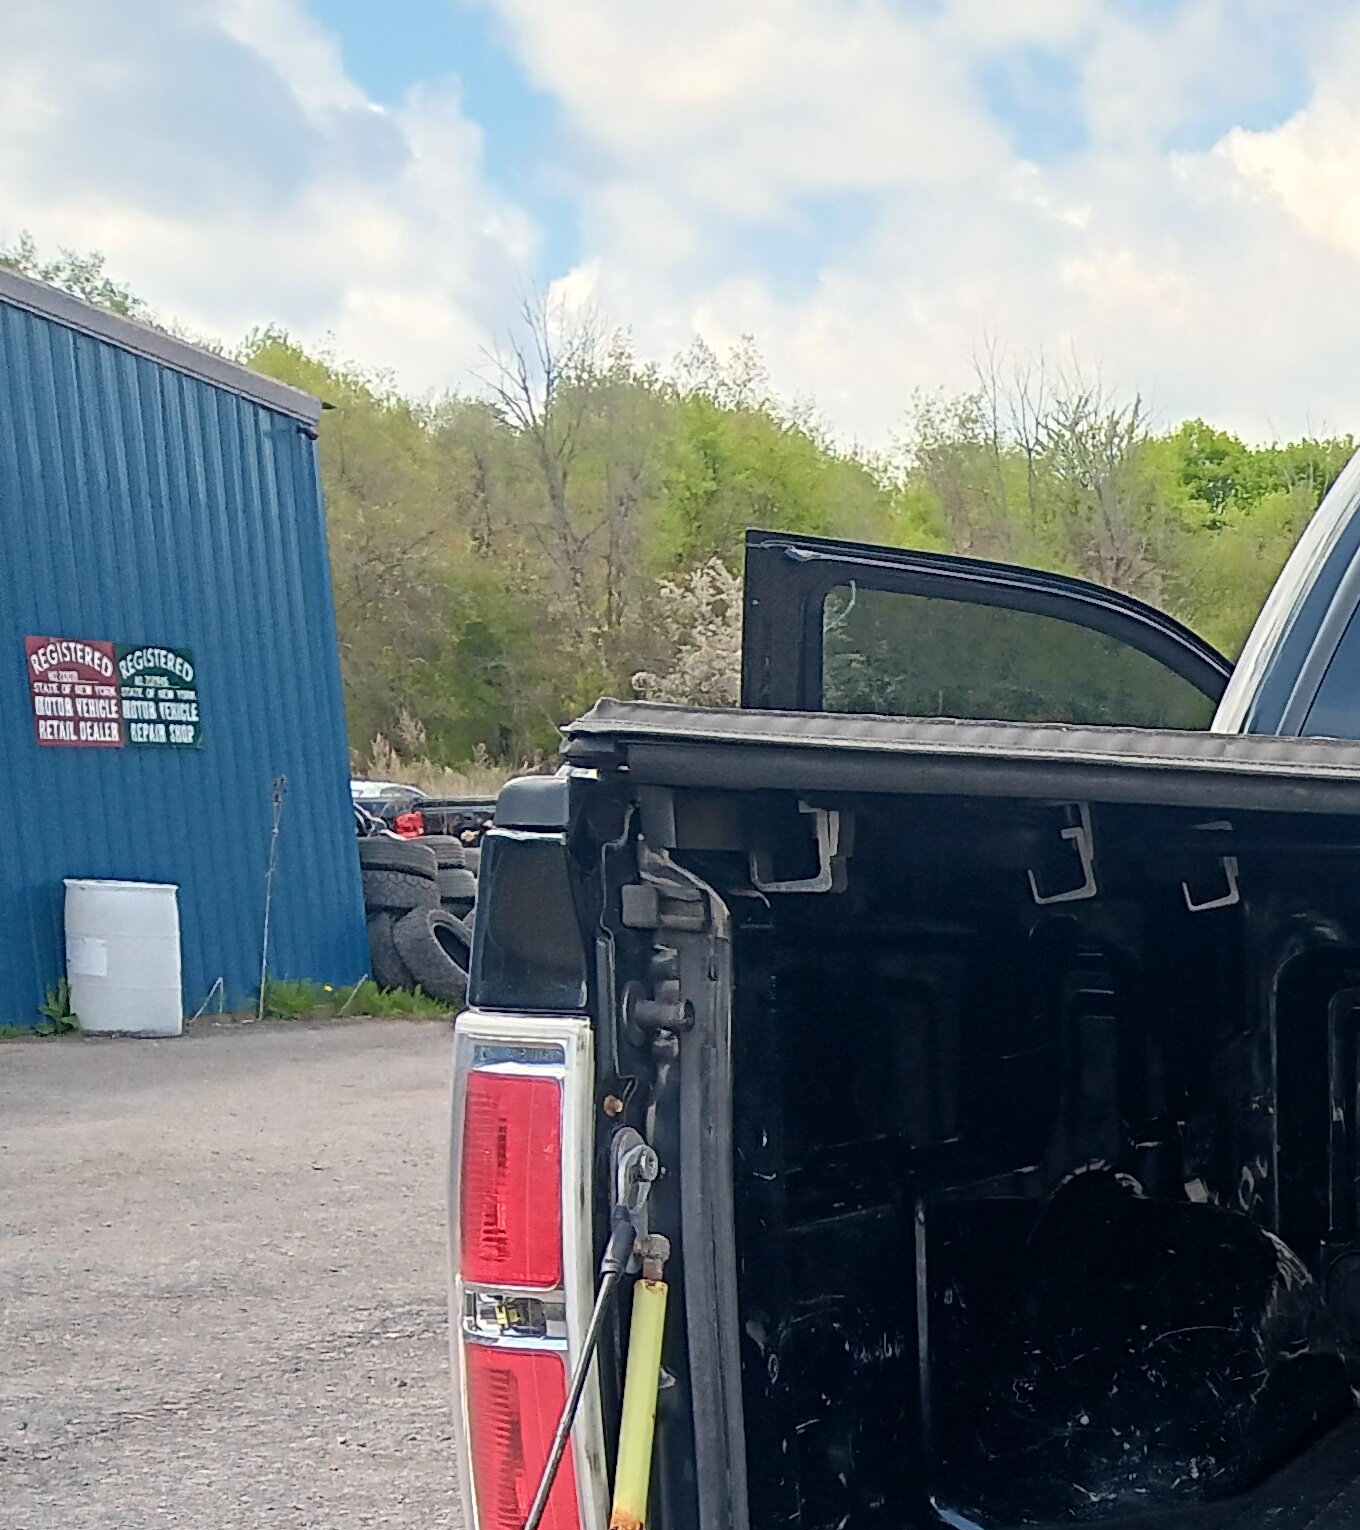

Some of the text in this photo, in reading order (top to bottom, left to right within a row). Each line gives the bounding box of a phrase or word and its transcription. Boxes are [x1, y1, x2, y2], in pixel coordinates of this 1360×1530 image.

[30, 641, 113, 677] REGISTERED
[119, 648, 194, 682] REGISTERED
[33, 682, 60, 694] STATE
[34, 696, 119, 718] MOTOR VEHICLE
[121, 700, 199, 721] MOTOR VEHICLE
[39, 719, 120, 742] RETAIL DEALER
[130, 723, 195, 743] REPAIR SHOP
